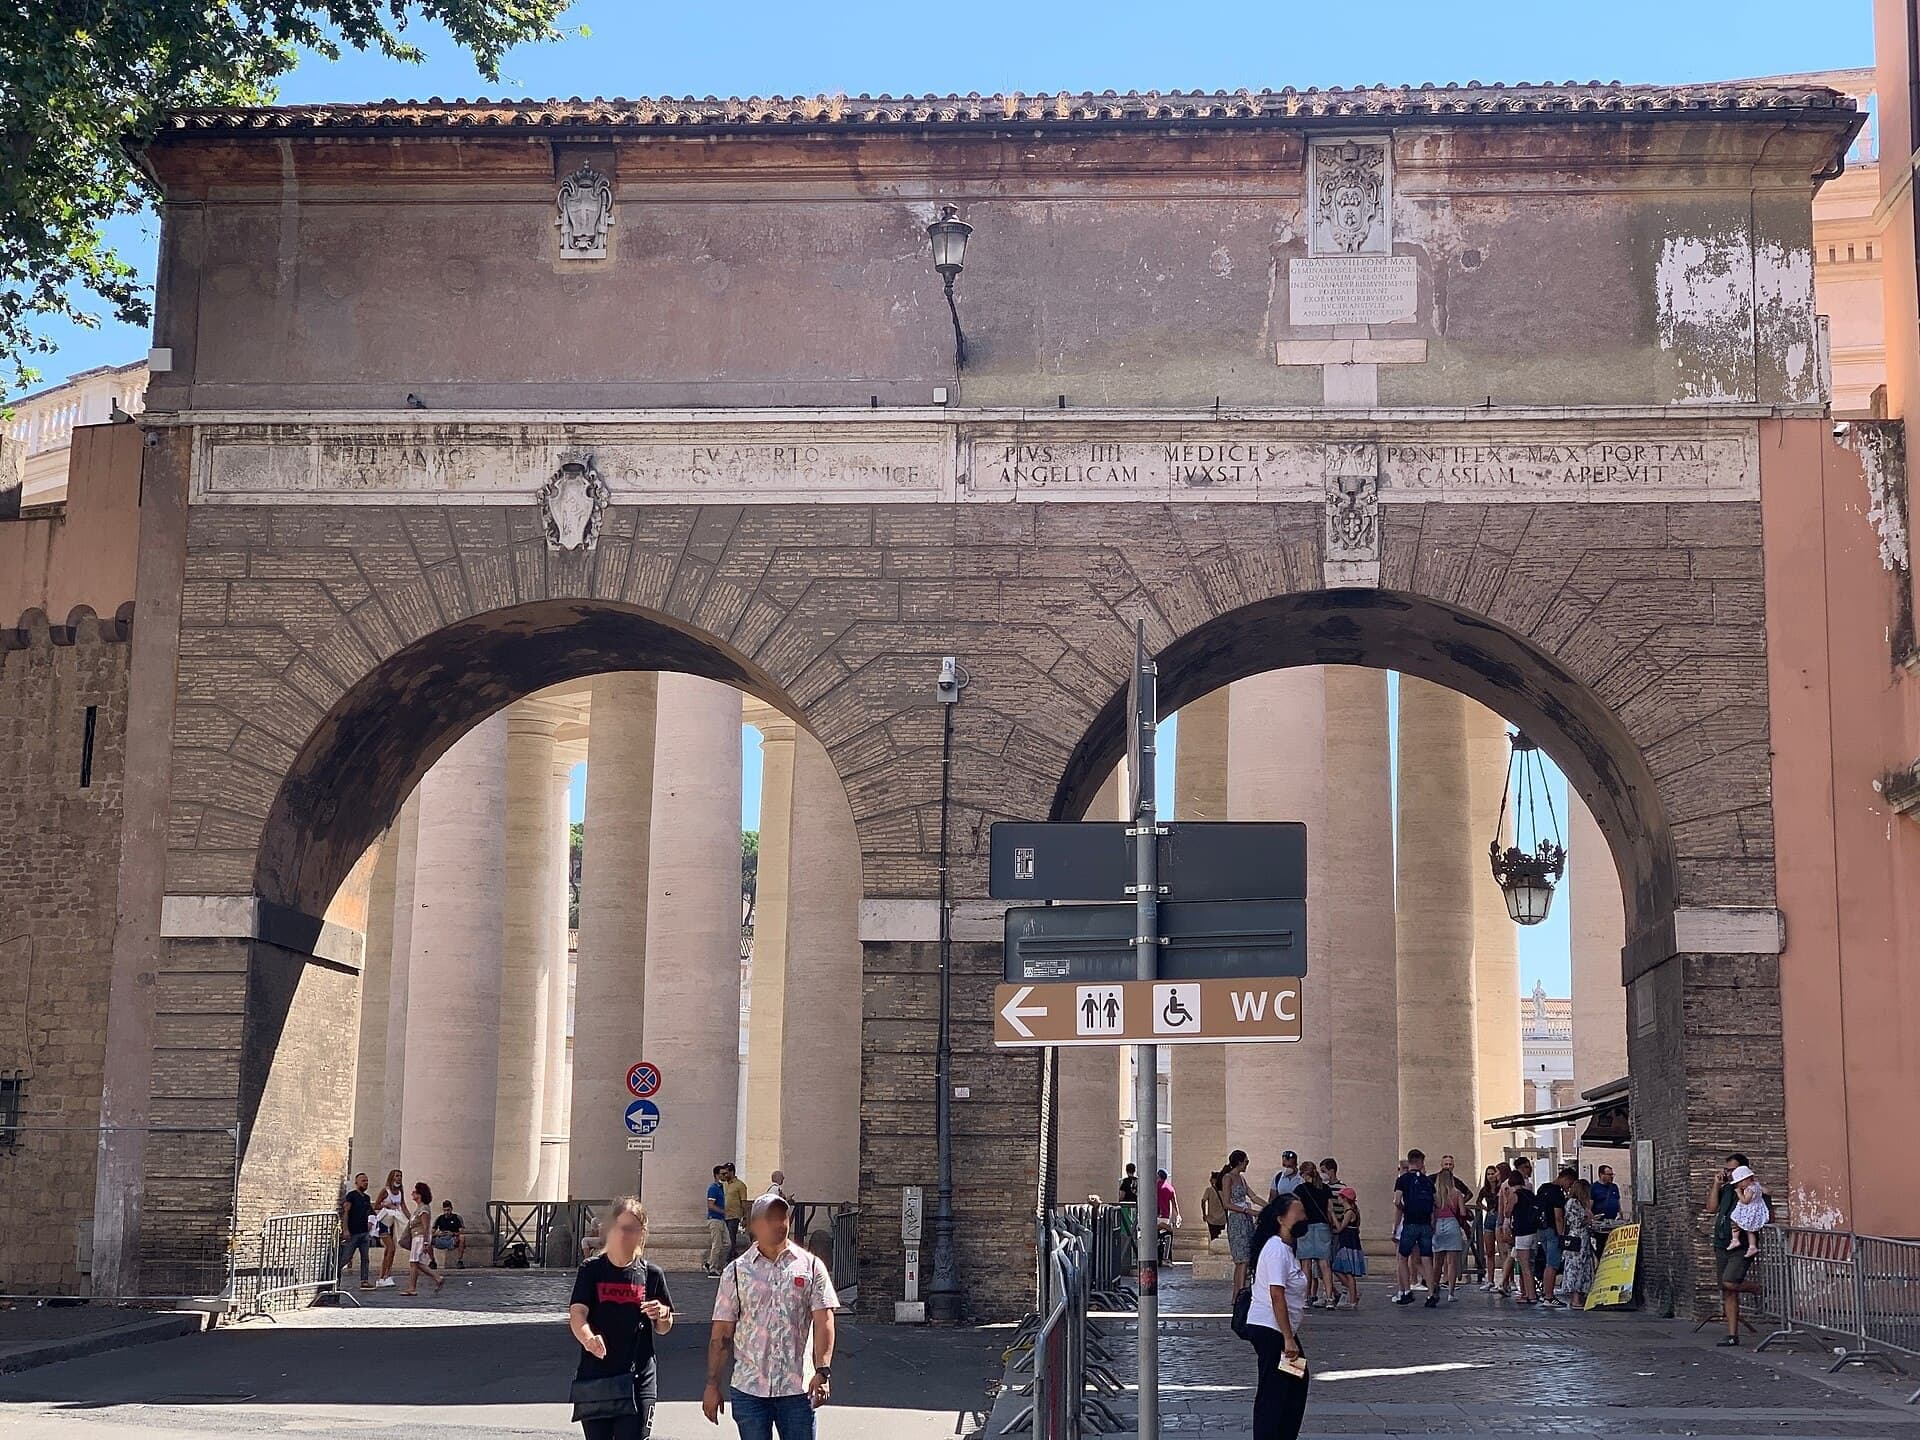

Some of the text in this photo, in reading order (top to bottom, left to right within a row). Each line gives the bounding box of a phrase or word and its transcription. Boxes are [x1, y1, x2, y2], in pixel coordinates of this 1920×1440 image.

[1005, 446, 1052, 463] PIVS
[1163, 445, 1276, 463] MEDICES
[1527, 446, 1580, 463] MAX
[1601, 444, 1706, 463] PORTAM
[999, 465, 1670, 485] ANGELICAM IVXSTA CASSIAM APERVIT
[1230, 989, 1297, 1023] WC
[1620, 1226, 1639, 1241] TOUR
